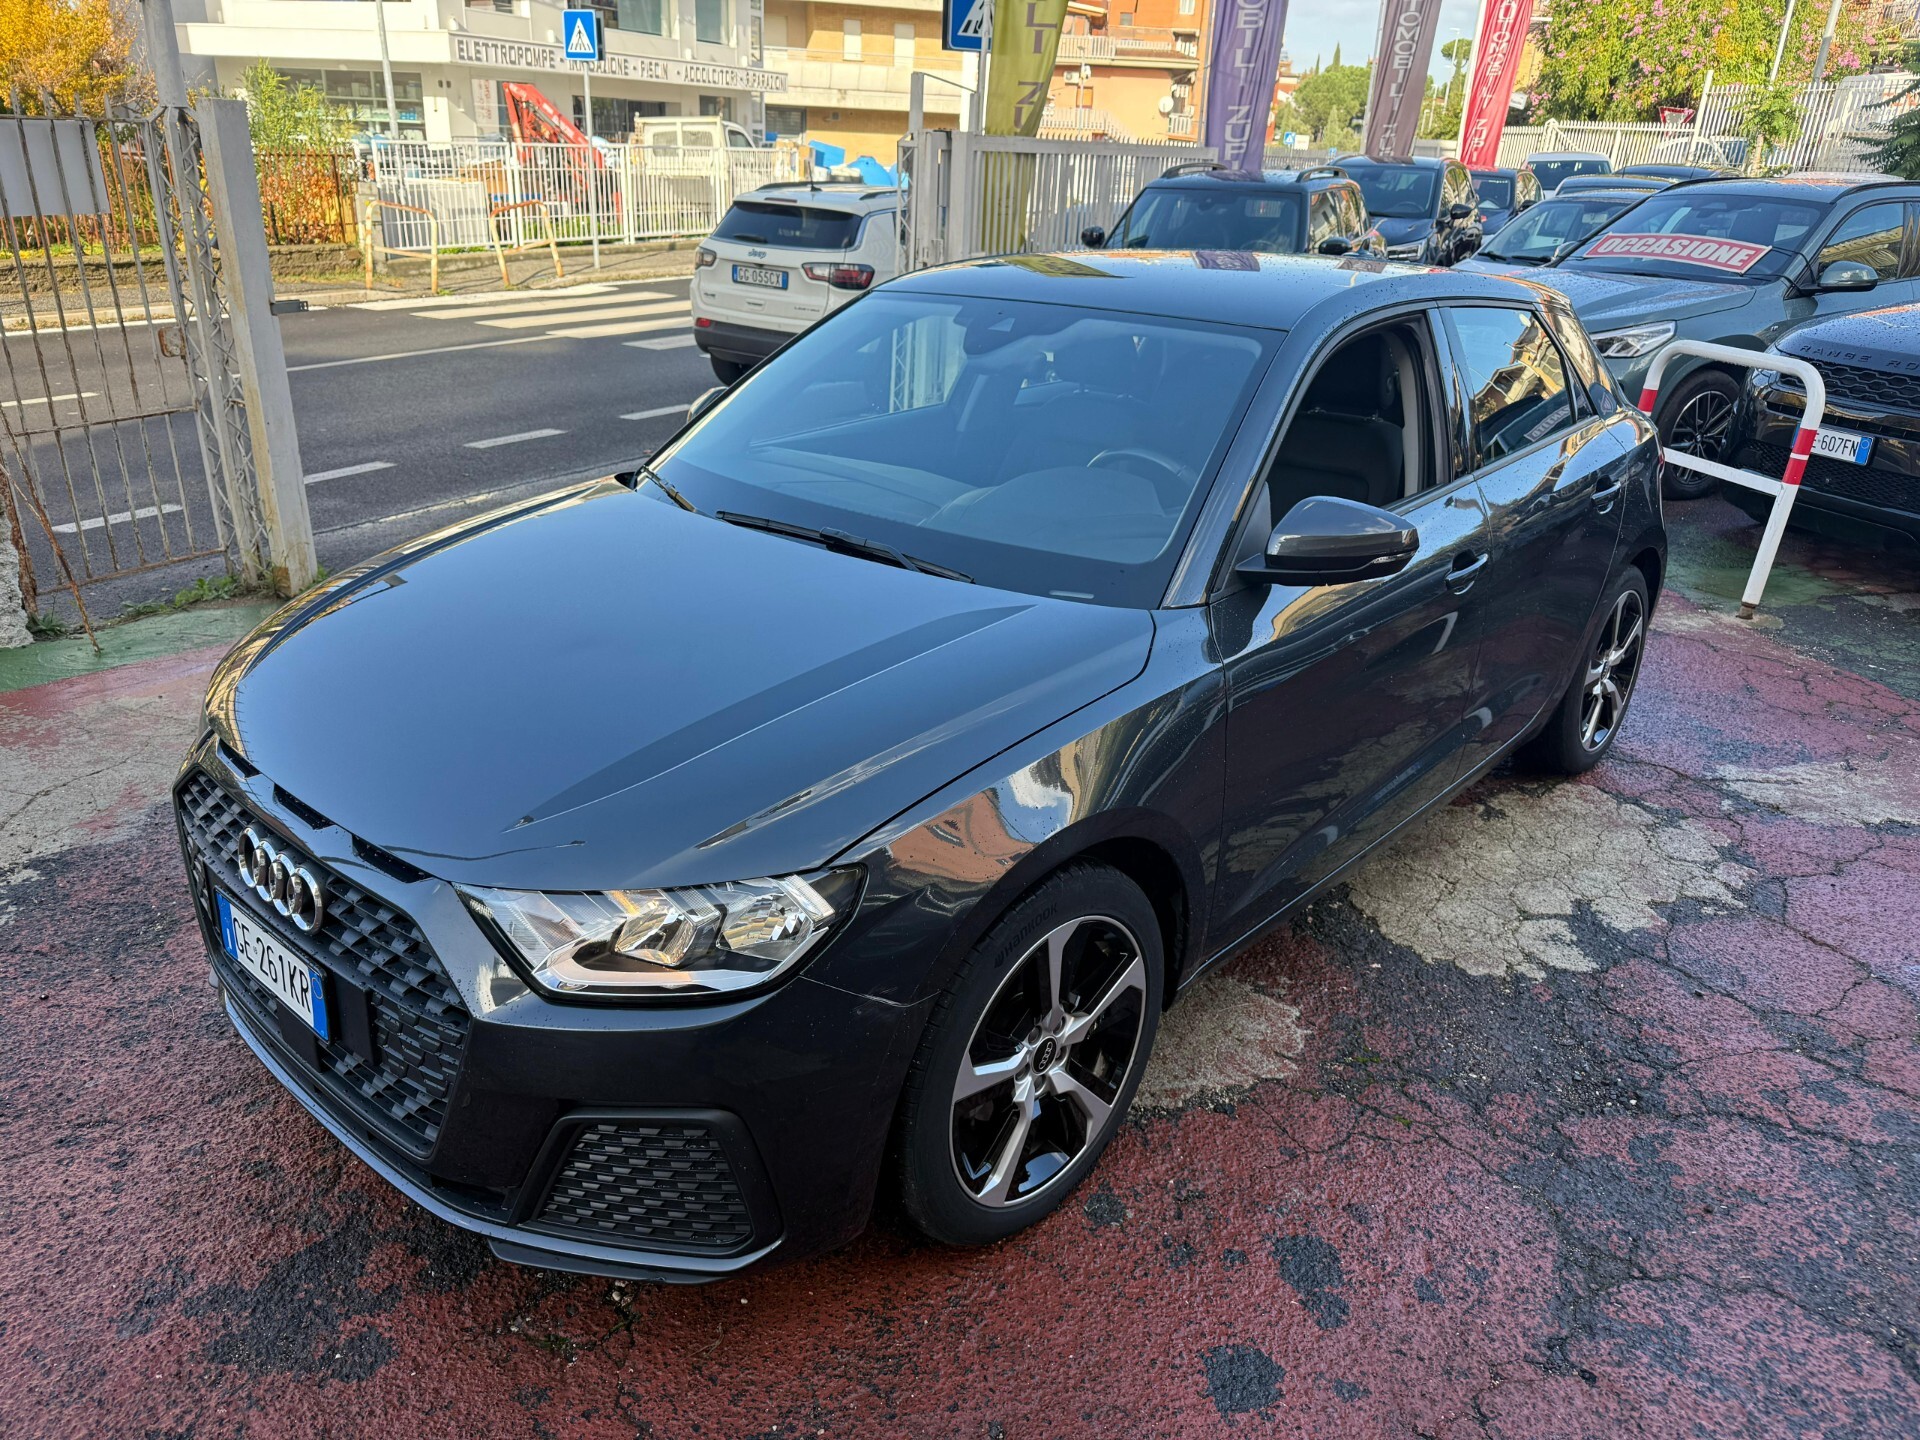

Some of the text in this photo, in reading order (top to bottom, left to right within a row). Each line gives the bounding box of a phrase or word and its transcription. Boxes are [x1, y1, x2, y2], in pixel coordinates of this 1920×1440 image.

[1026, 0, 1058, 54] LI
[457, 39, 556, 69] ELETTROPOMPE
[1597, 237, 1756, 267] OCCASIONE
[1800, 345, 1872, 363] RANGE
[1820, 434, 1860, 457] 607FN
[232, 916, 311, 1014] GE 261KR
